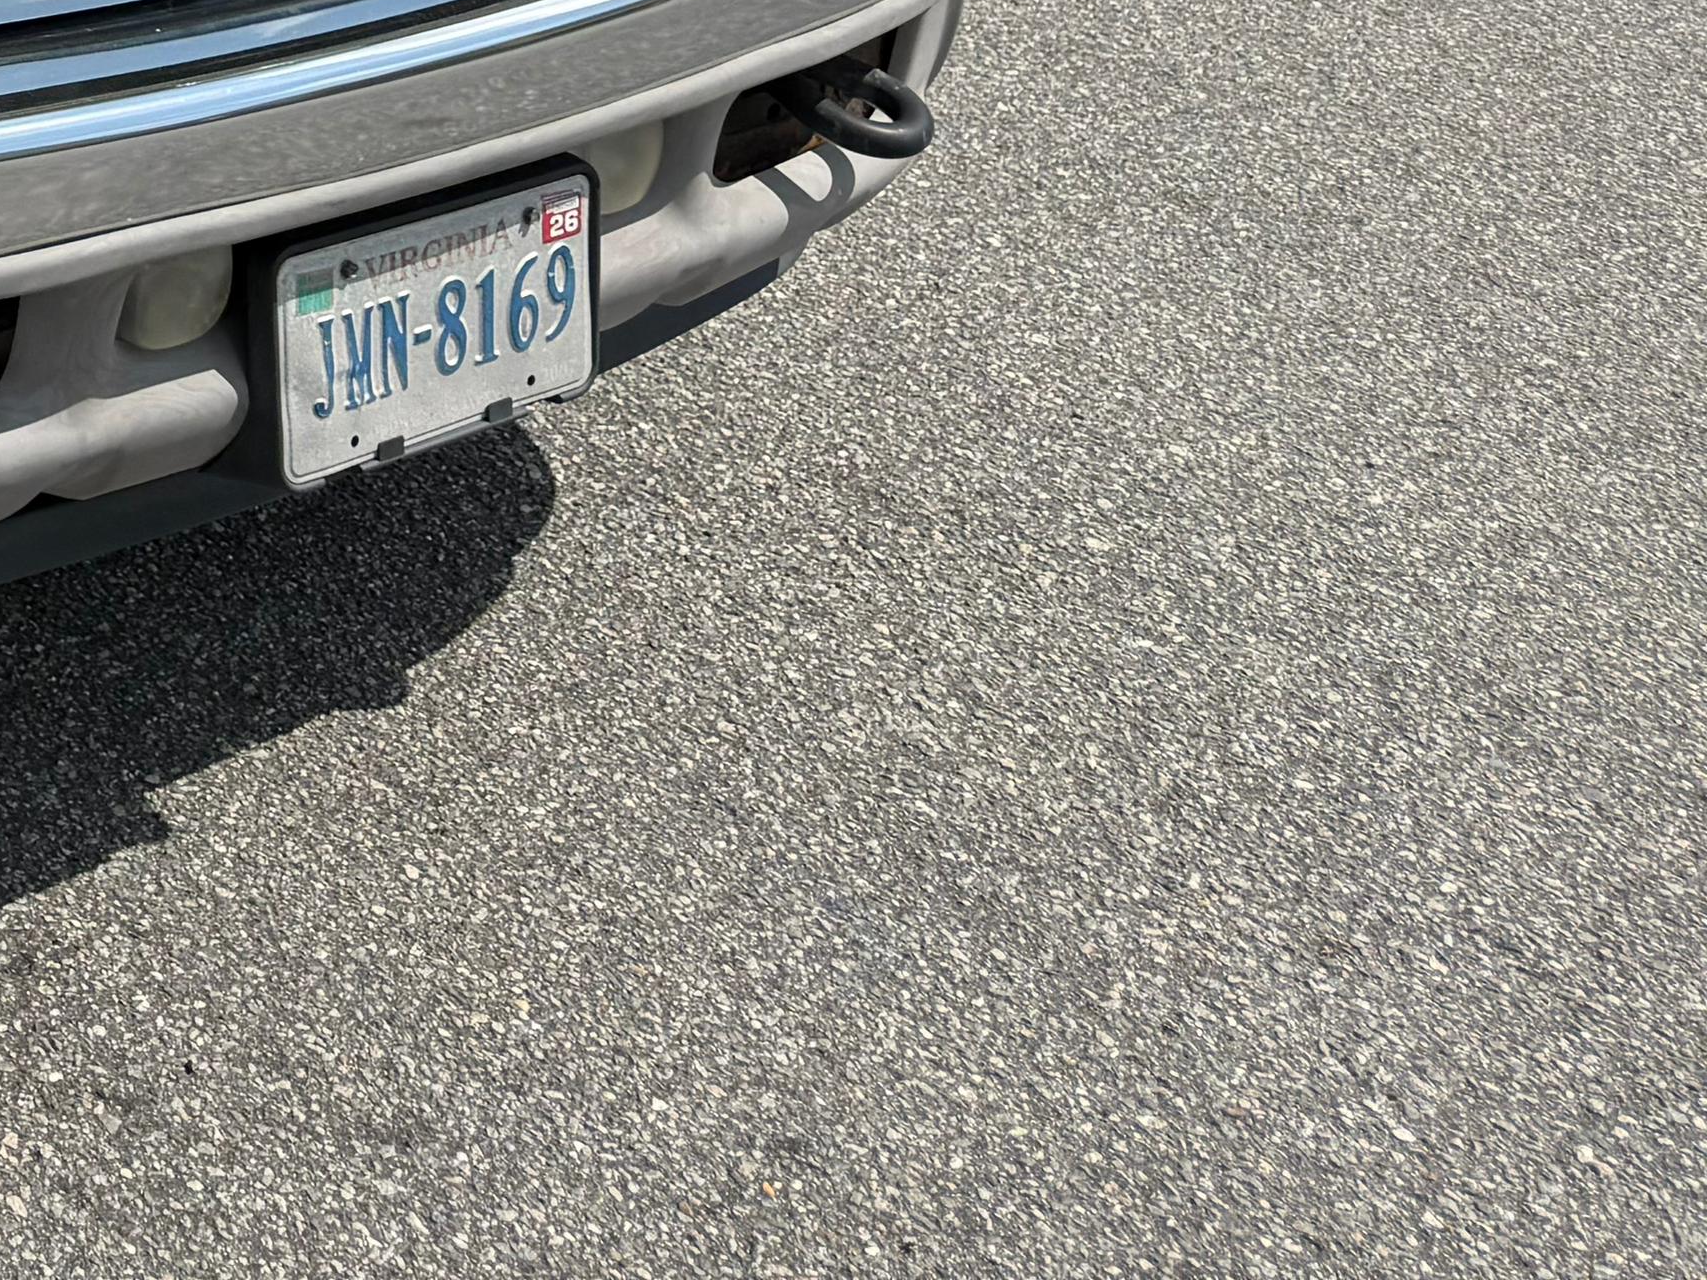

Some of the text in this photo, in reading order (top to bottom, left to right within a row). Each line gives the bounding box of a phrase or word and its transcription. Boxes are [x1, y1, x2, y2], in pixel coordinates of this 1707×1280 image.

[362, 217, 513, 286] VIRGINIA
[548, 208, 579, 239] 26
[311, 241, 577, 420] JMN-8169
